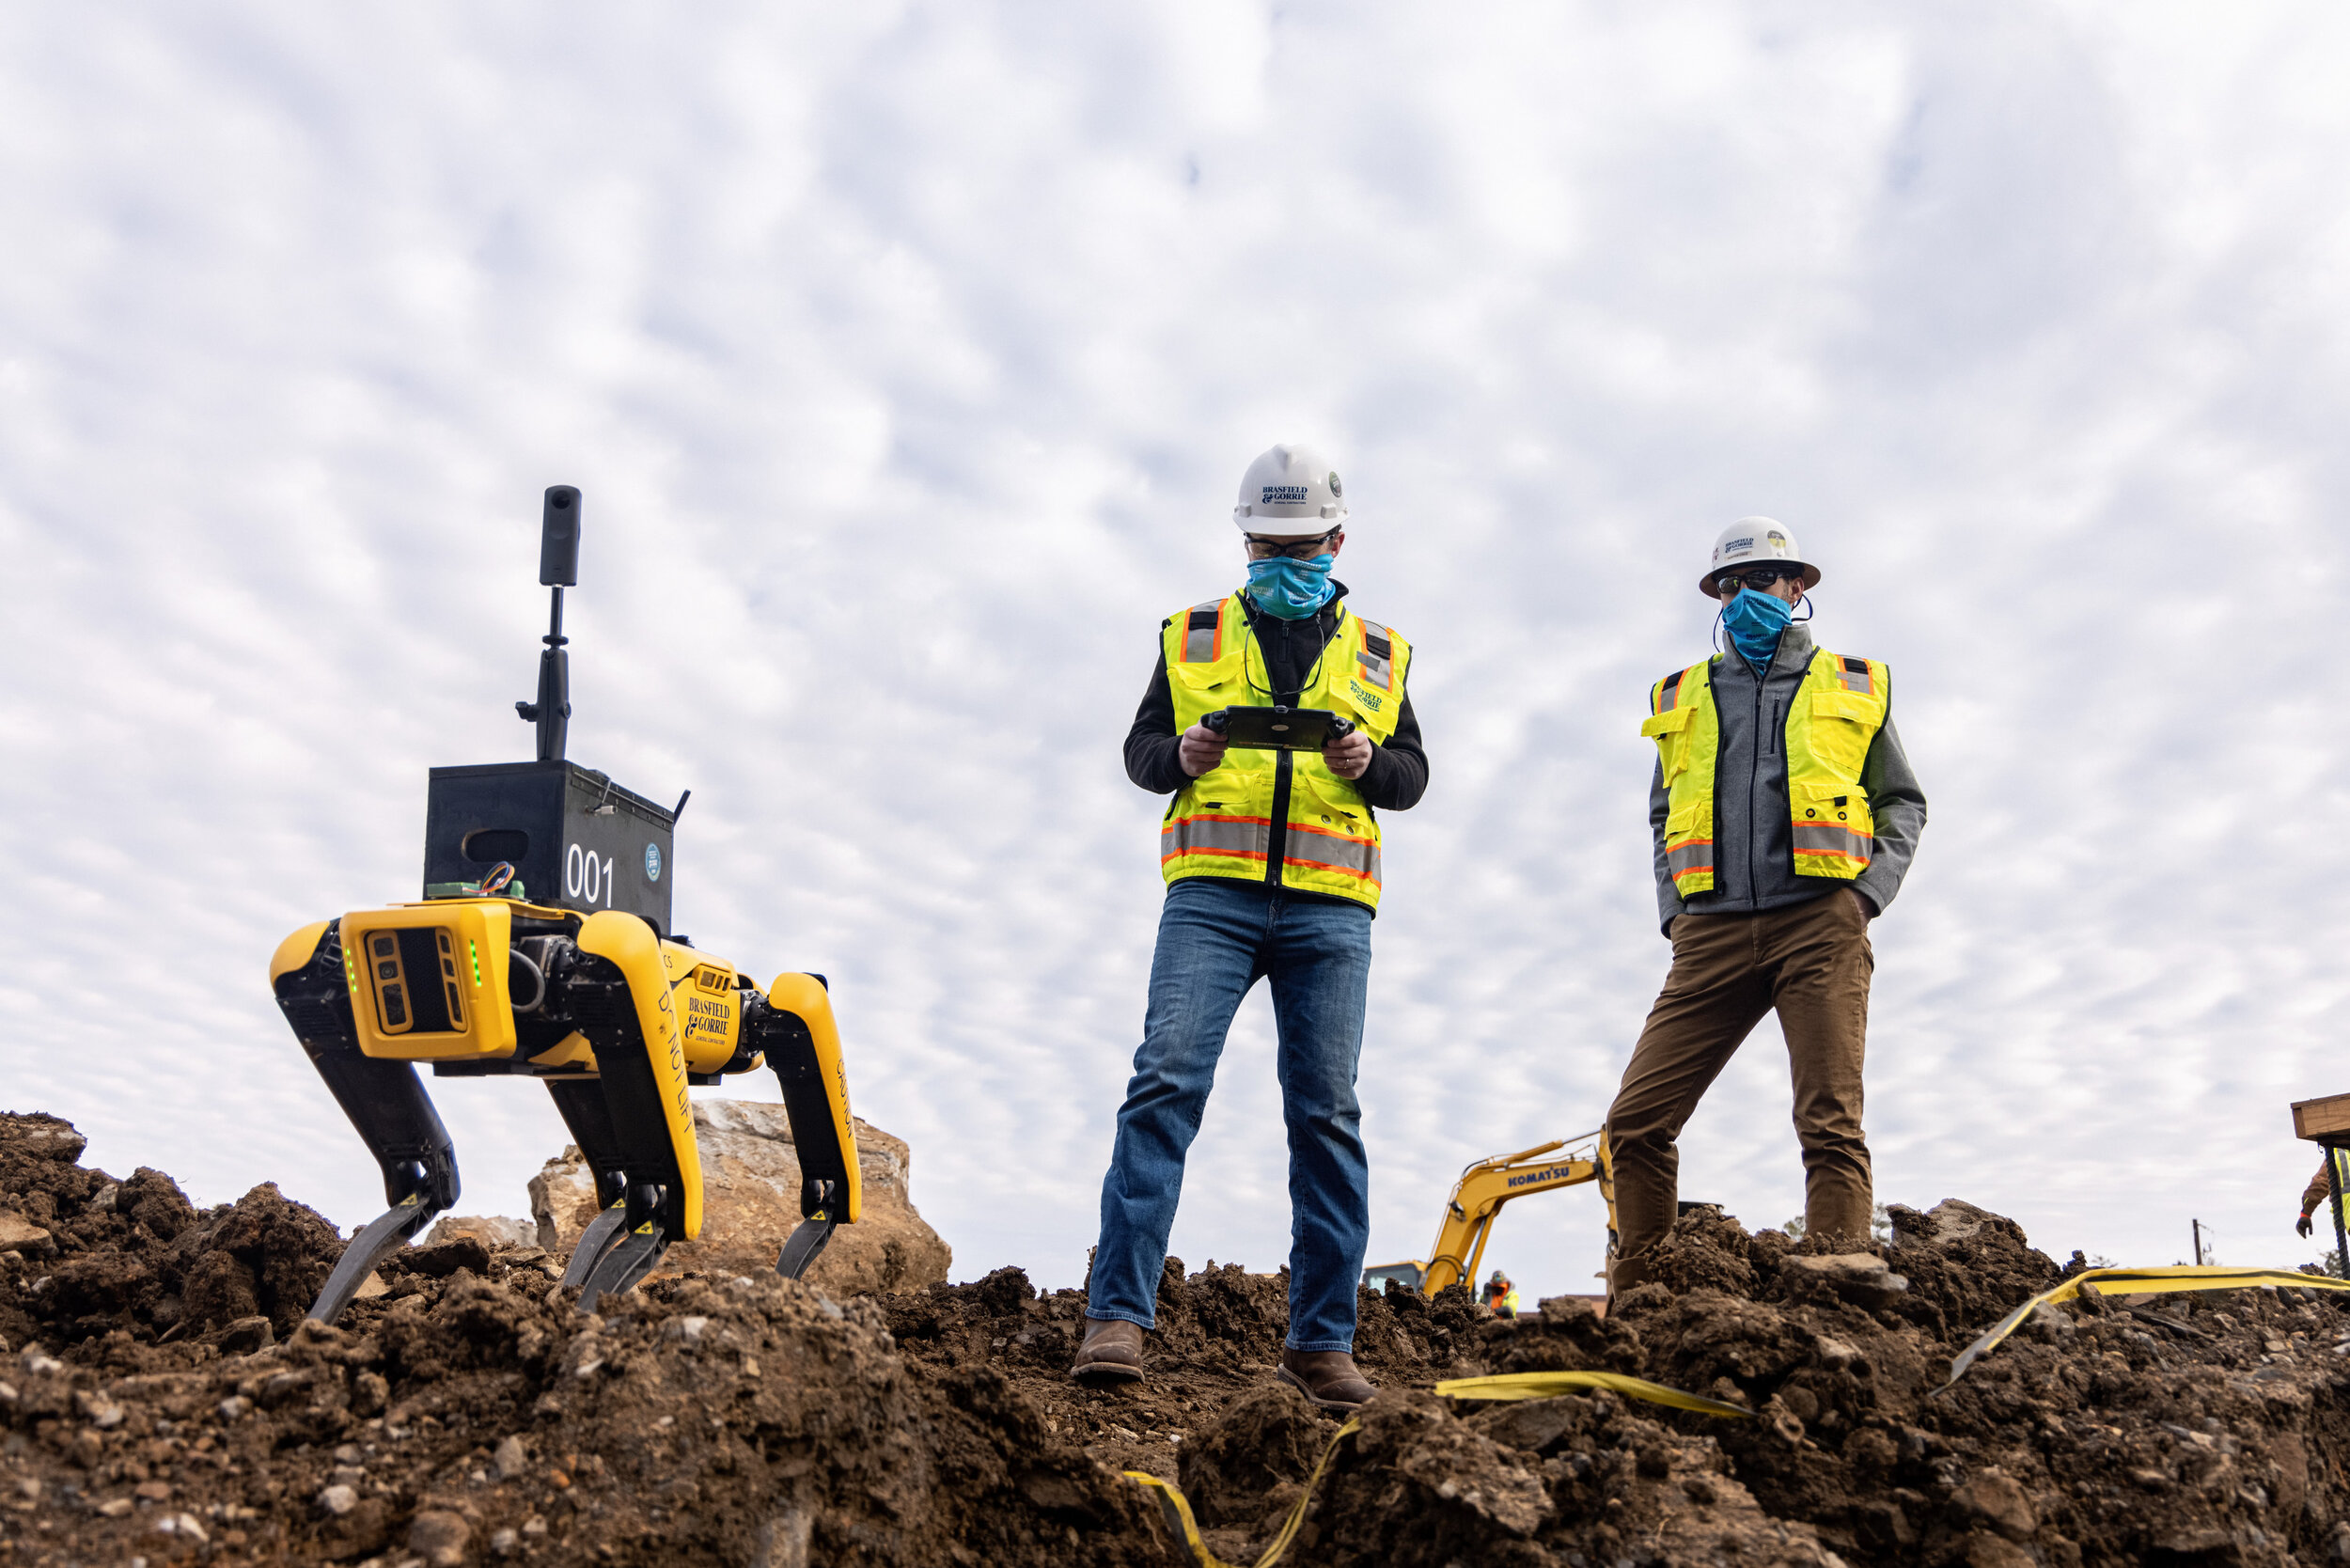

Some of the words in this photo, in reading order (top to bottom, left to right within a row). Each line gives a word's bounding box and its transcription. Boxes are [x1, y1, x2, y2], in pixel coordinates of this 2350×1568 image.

[1262, 494, 1274, 504] &
[567, 843, 613, 909] 001
[689, 996, 730, 1019] BRASFIELD
[685, 1013, 697, 1039] &
[698, 1016, 728, 1035] GORRIE
[667, 1032, 684, 1082] NOT
[677, 1085, 693, 1134] LIFT
[1508, 1167, 1570, 1187] KOMATSU
